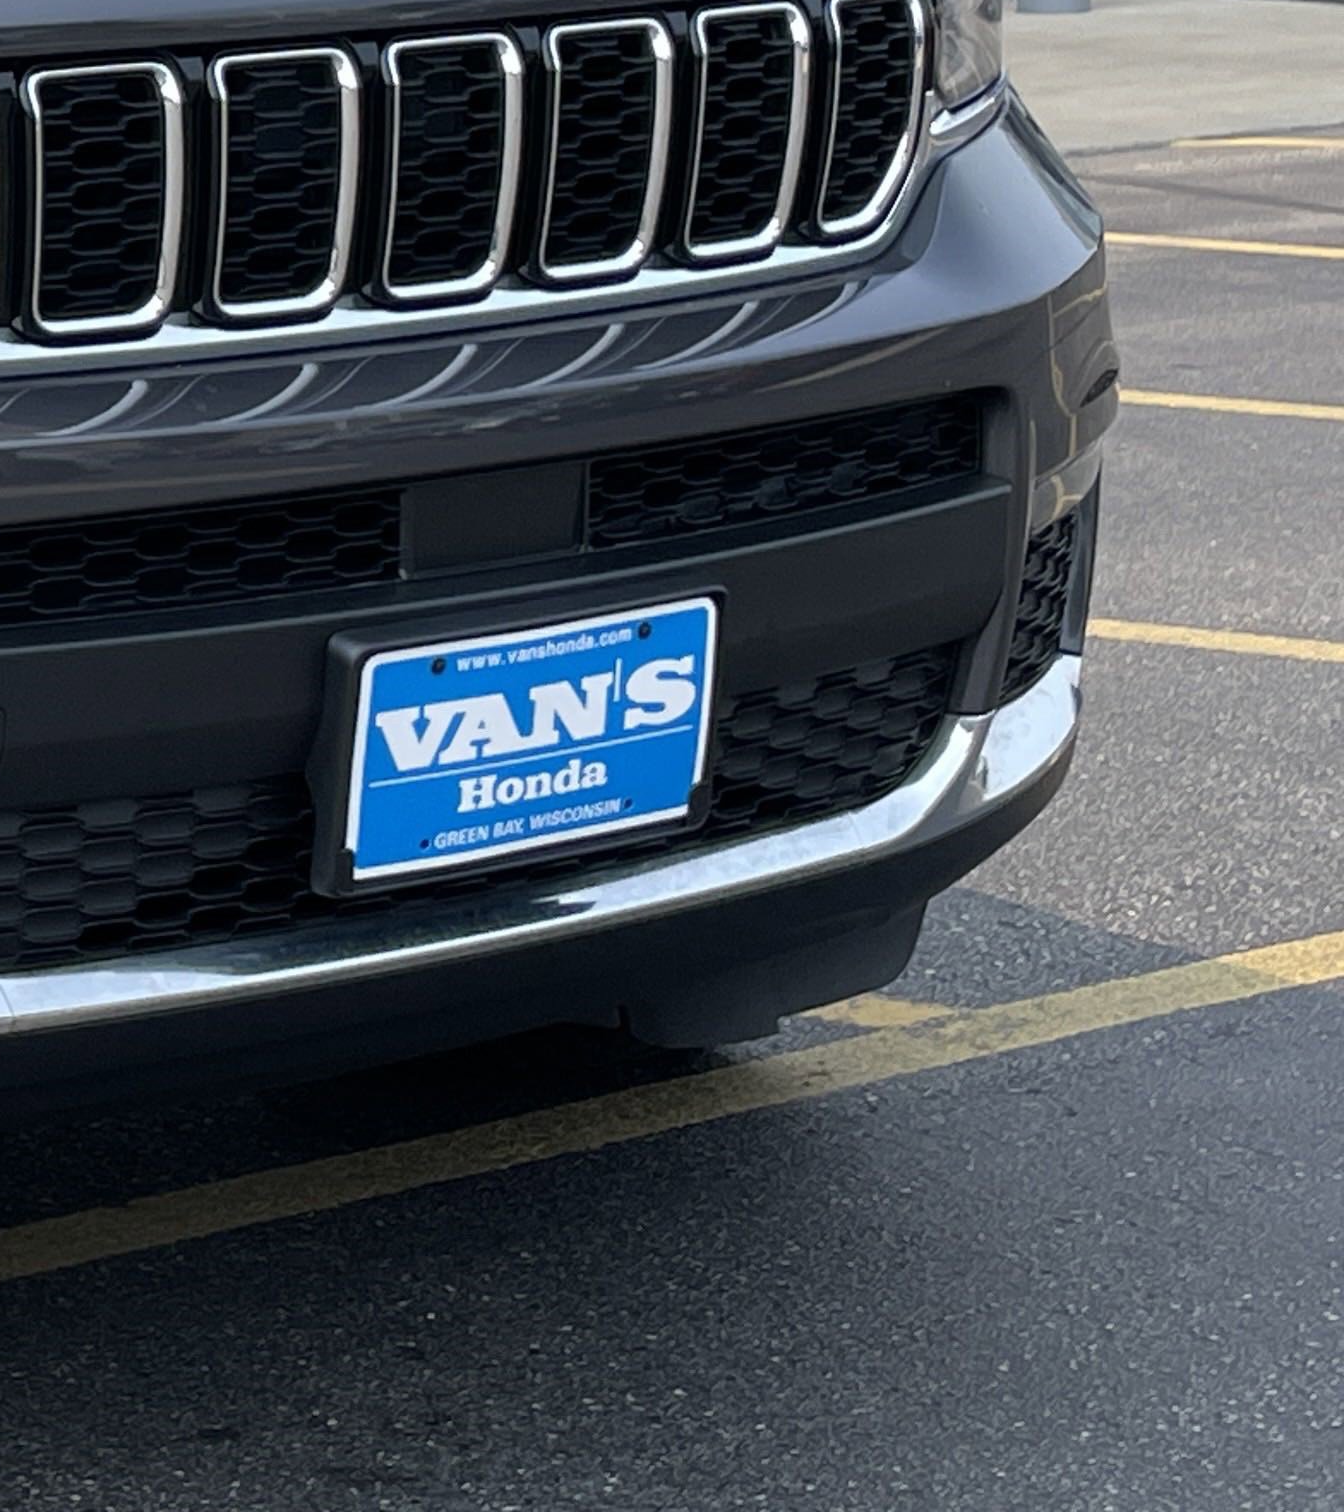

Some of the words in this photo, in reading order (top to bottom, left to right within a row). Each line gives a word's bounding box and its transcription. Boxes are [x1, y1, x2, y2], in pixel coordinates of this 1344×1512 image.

[456, 627, 632, 672] www.vanshonda.com
[375, 654, 697, 773] VAN'S
[456, 758, 608, 814] Honda
[434, 826, 489, 850] GREEN
[529, 797, 622, 831] WISCONSIN
